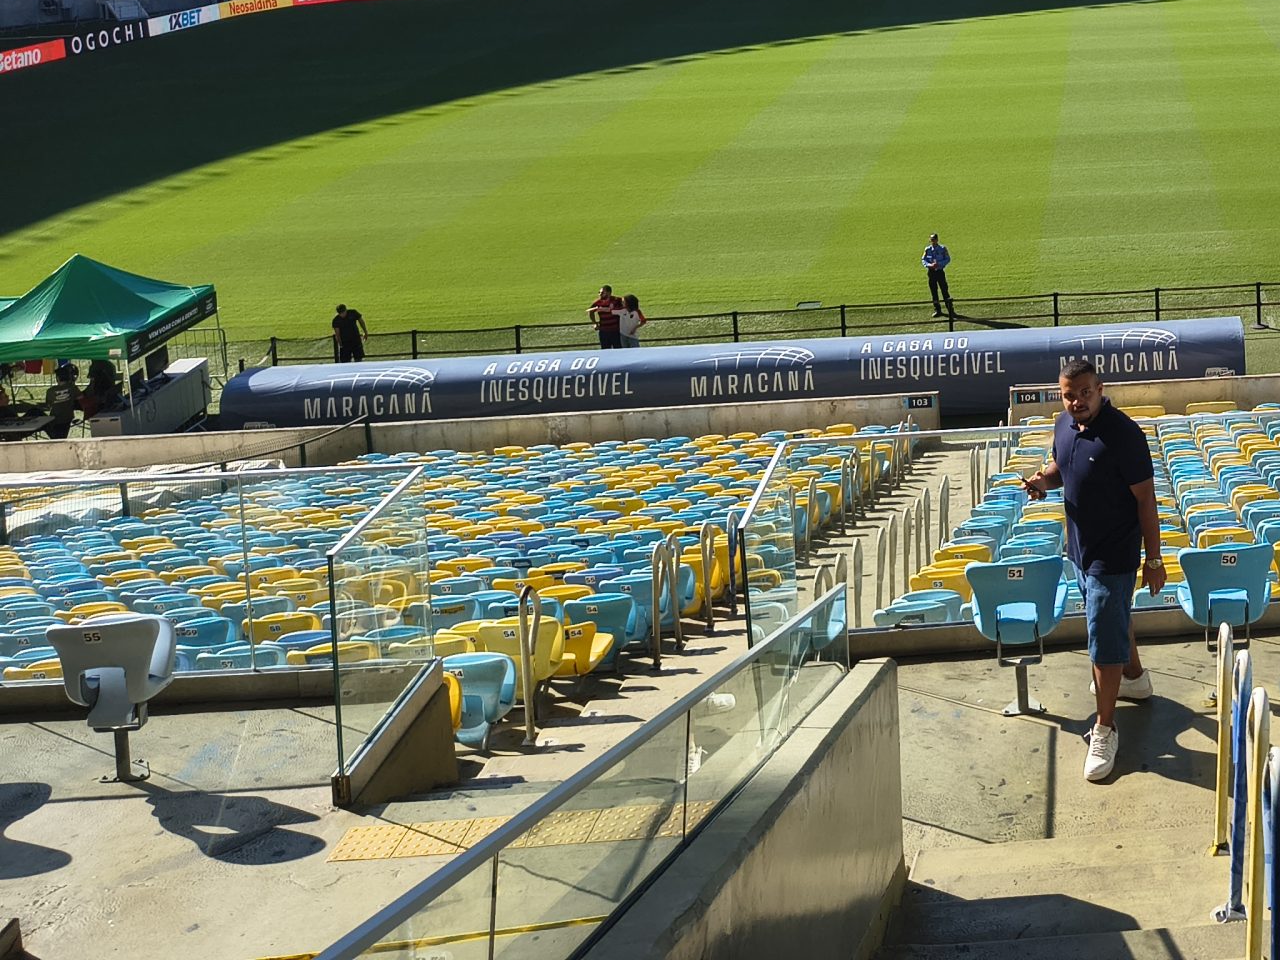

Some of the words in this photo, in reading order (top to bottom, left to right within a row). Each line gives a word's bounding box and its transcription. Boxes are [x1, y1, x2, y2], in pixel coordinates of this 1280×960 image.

[169, 9, 202, 30] 1XBET
[72, 22, 144, 54] OGOCHI
[861, 343, 872, 354] A
[883, 340, 933, 353] CASA
[944, 337, 969, 350] DO
[483, 363, 498, 375] A
[507, 359, 561, 374] CASA
[571, 357, 599, 371] DO
[861, 350, 1005, 380] INESQUECÍVEL
[481, 370, 633, 403] INESQUECÍVEL
[691, 366, 814, 398] MARACANÃ
[305, 388, 432, 419] MARACANÃ
[1021, 394, 1036, 402] 104
[1222, 556, 1237, 564] 50
[1009, 570, 1023, 578] 51
[933, 580, 943, 588] 53
[84, 633, 100, 641] 55
